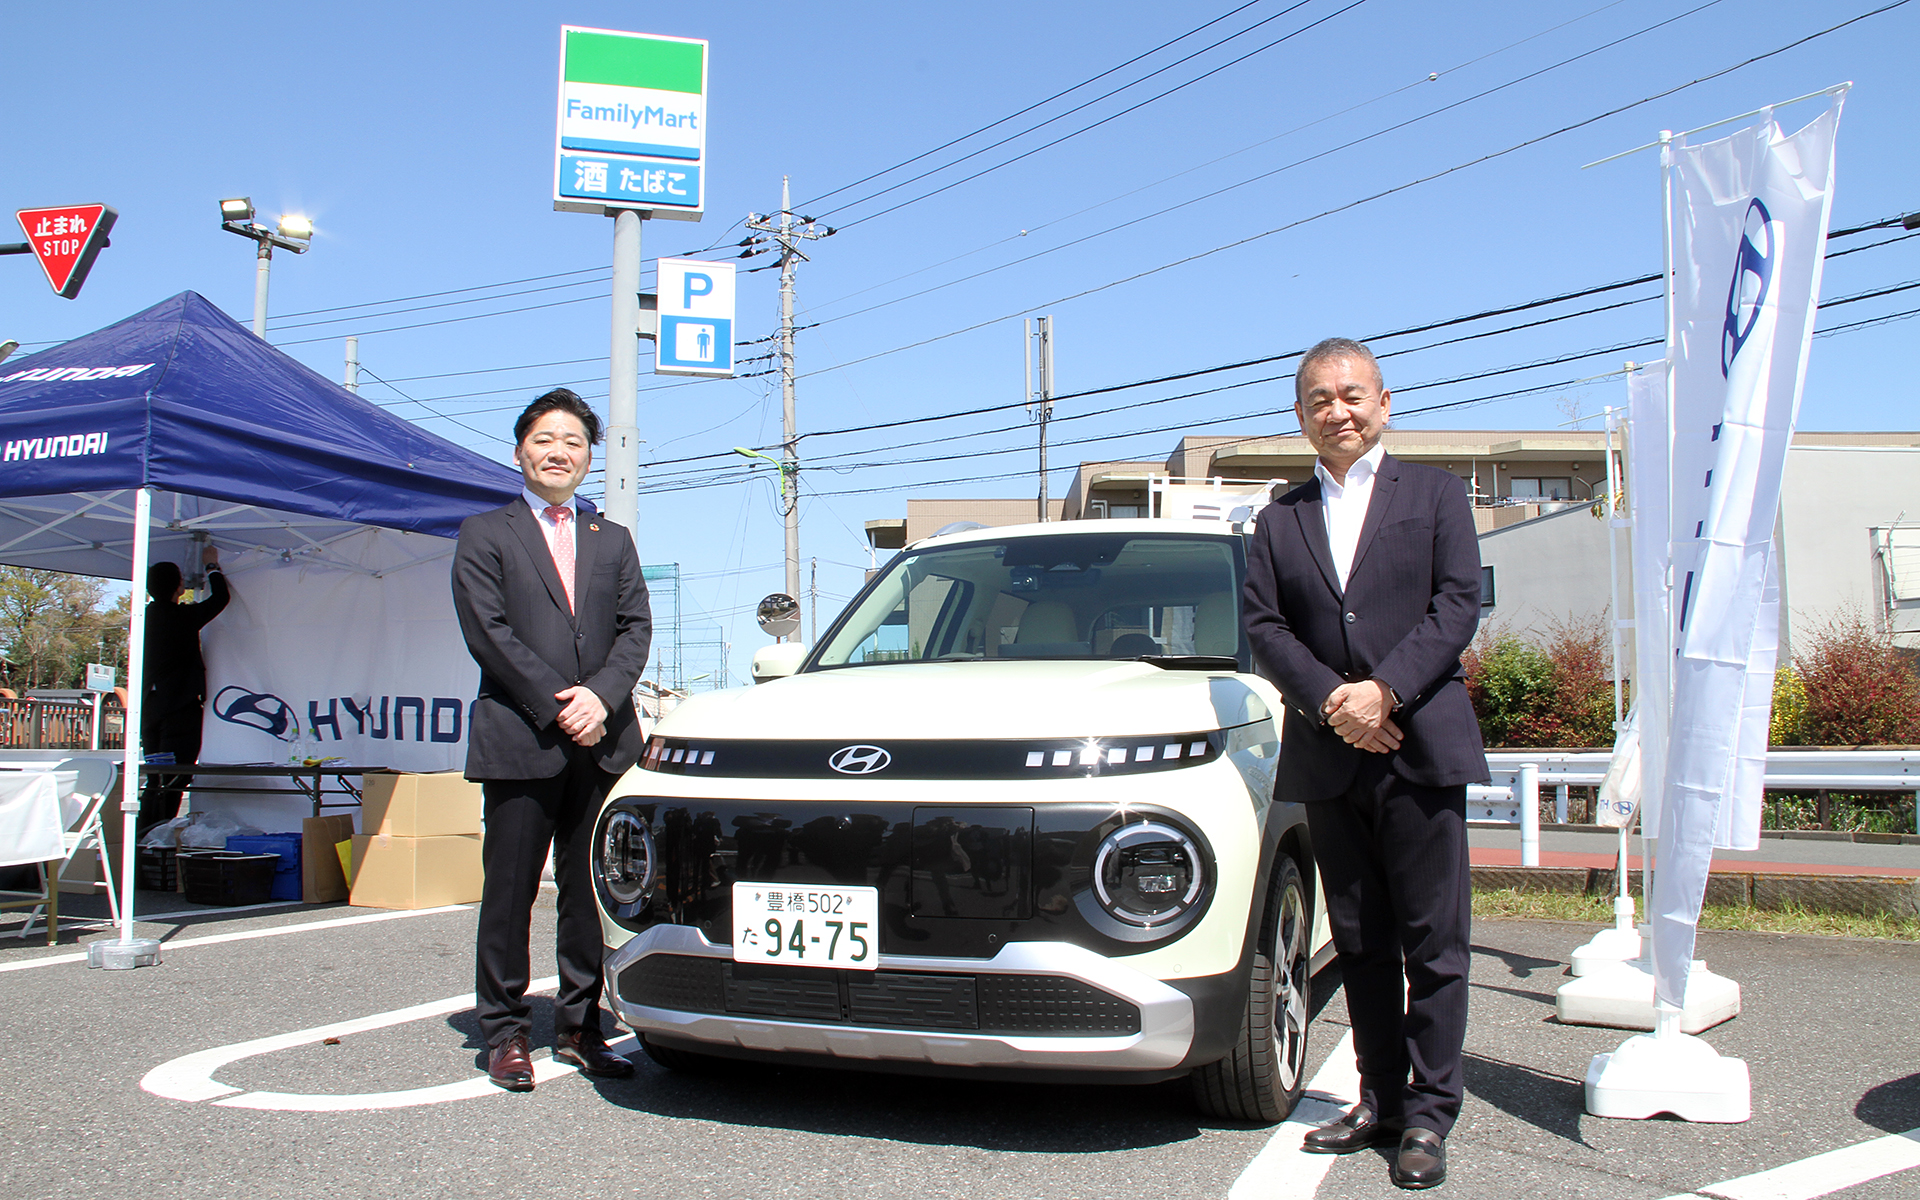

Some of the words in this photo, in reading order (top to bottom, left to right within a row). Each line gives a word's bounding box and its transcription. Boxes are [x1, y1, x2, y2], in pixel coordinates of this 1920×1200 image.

[566, 98, 698, 130] FamilyMart
[574, 160, 609, 193] 酒
[619, 167, 687, 196] たばこ
[34, 214, 88, 237] 止まれ
[43, 239, 79, 257] STOP
[683, 271, 714, 310] P
[3, 431, 109, 461] HYUNDAI
[308, 695, 477, 743] HYUND
[765, 917, 868, 962] 94-75
